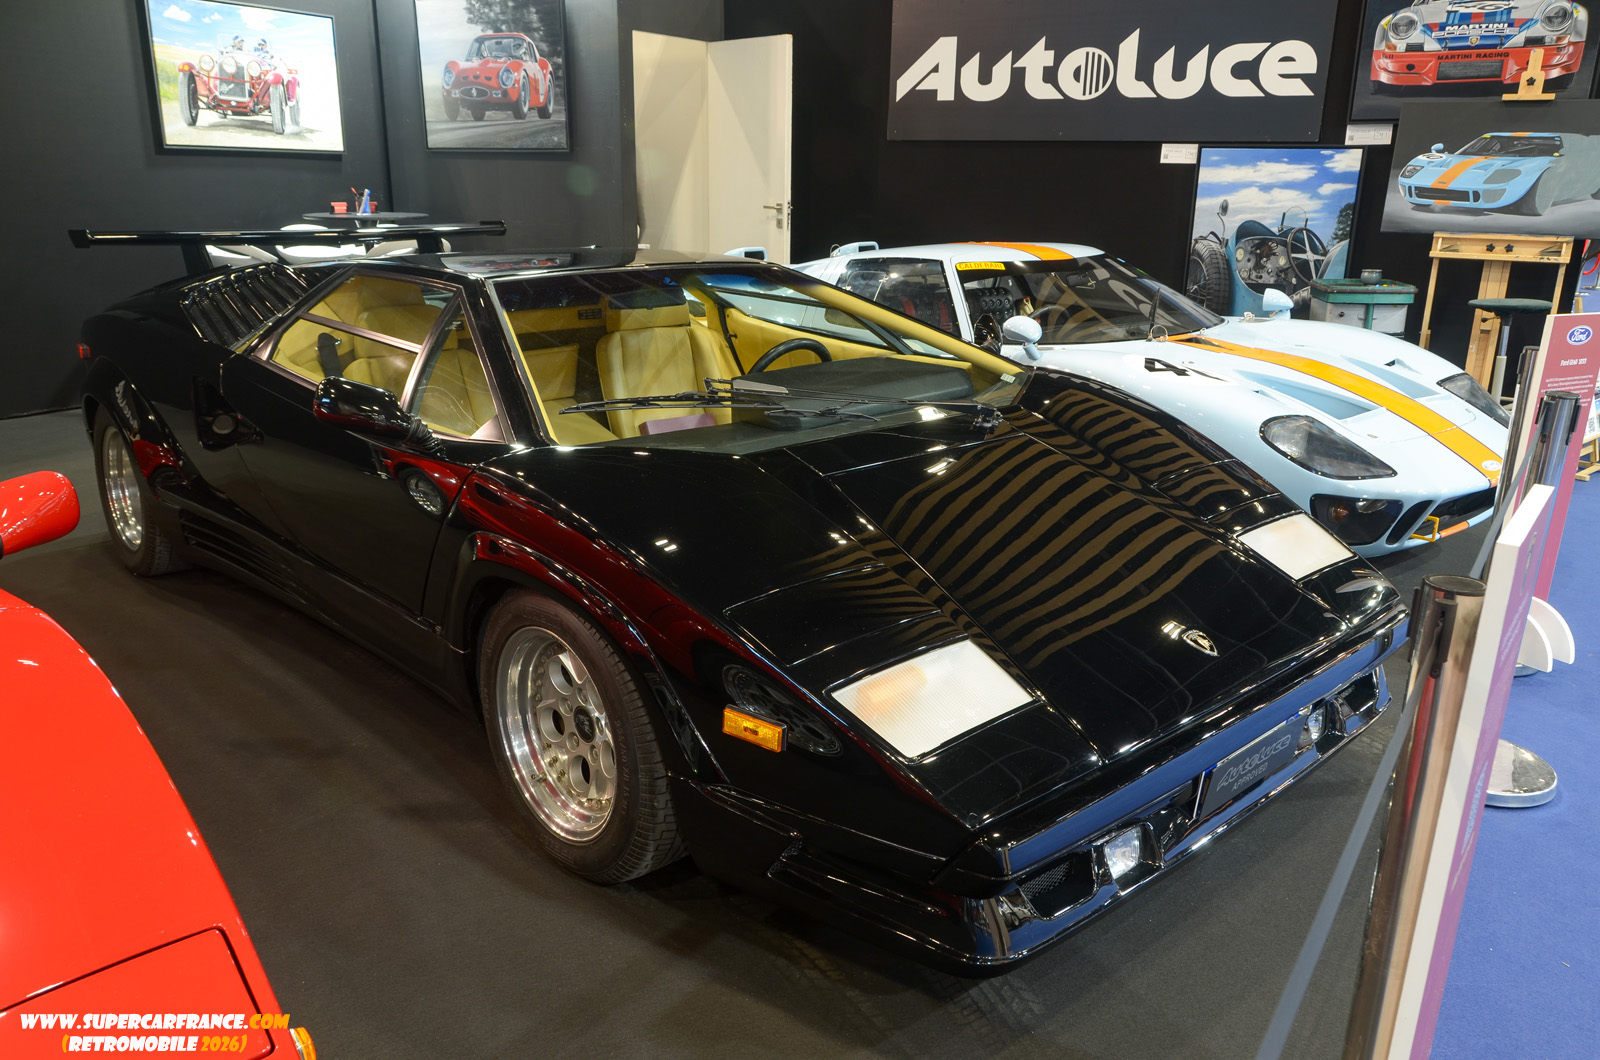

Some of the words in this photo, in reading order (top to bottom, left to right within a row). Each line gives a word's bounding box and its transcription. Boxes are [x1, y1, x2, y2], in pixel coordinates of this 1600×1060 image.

[1432, 27, 1520, 38] PORSCHE
[1445, 23, 1508, 31] MARTINI
[1232, 762, 1268, 791] APPROVED
